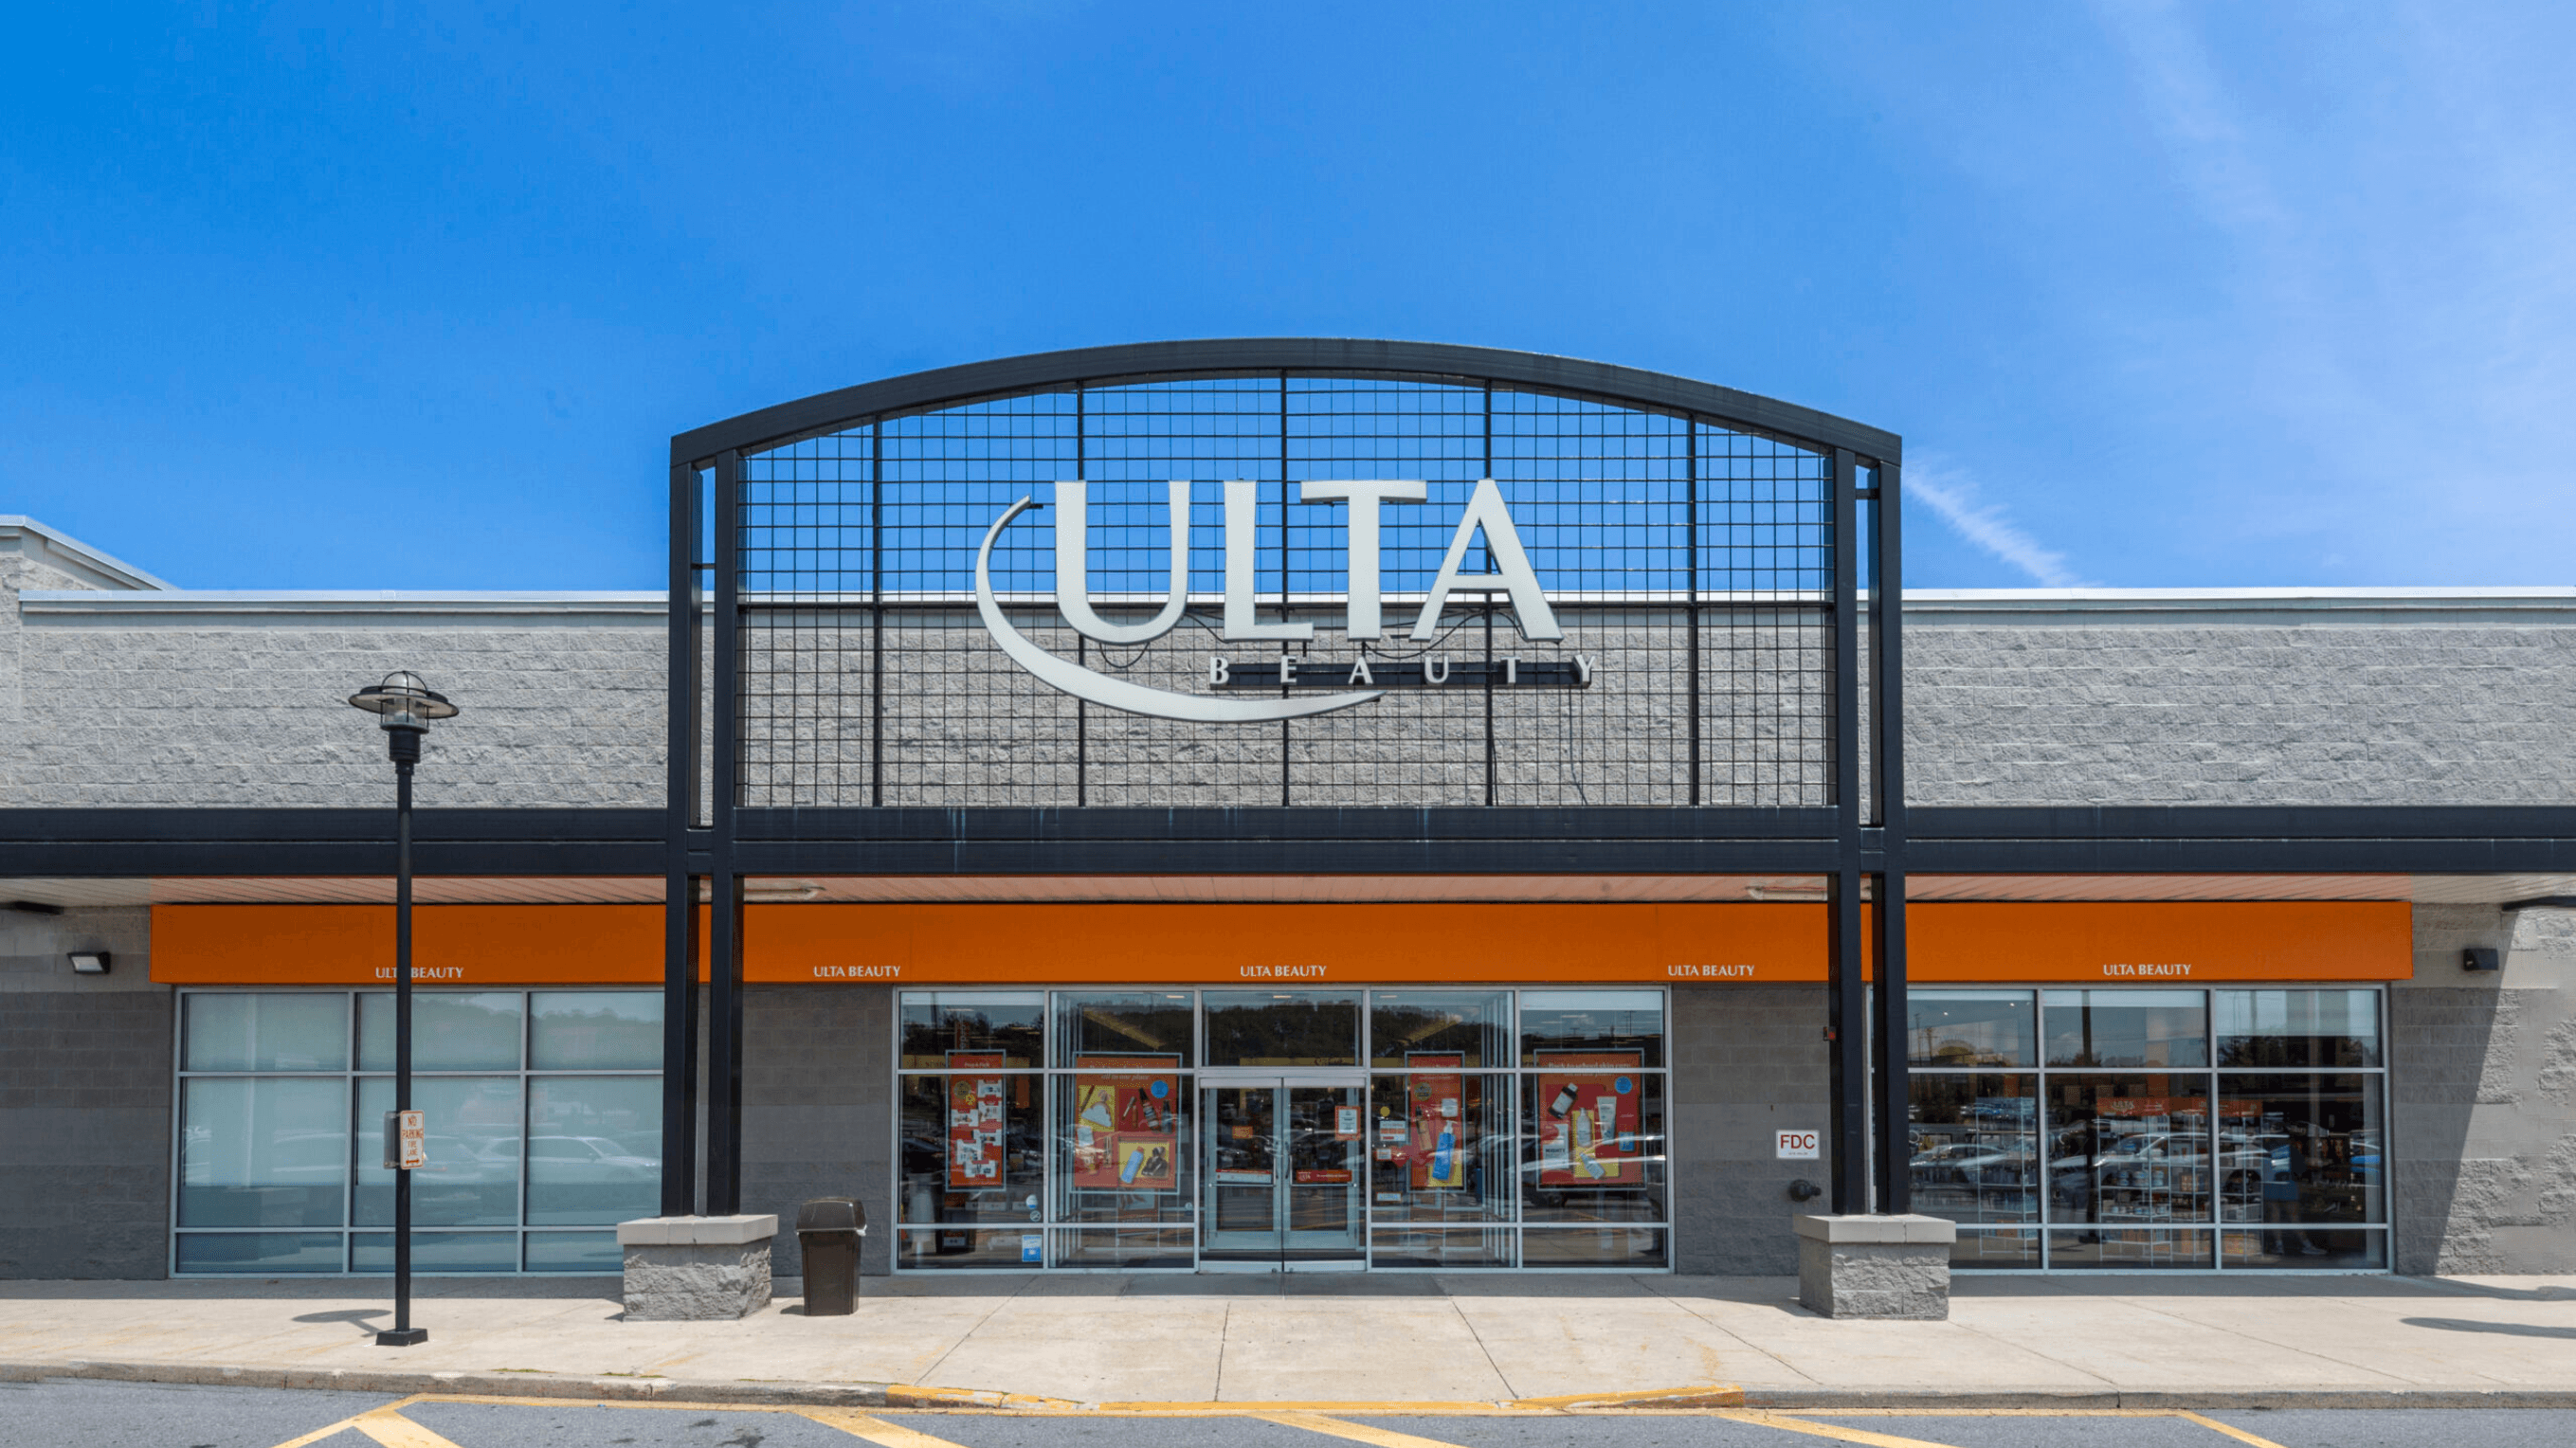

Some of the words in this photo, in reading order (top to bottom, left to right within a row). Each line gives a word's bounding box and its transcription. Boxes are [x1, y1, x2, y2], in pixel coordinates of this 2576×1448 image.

[1055, 478, 1565, 646] ULTA
[1208, 654, 1596, 688] BEAUTY
[375, 967, 397, 978] ULT
[410, 967, 463, 978] BEAUTY
[814, 966, 845, 977] ULTA
[848, 966, 900, 977] BEAUTY
[1241, 966, 1272, 977] ULTA
[1275, 965, 1327, 977] BEAUTY
[1668, 965, 1699, 976] ULTA
[1702, 965, 1754, 976] BEAUTY
[2103, 964, 2135, 976] ULTA
[2138, 964, 2191, 976] BEAUTY
[408, 1115, 418, 1127] NO
[402, 1129, 424, 1139] PARKING
[1780, 1134, 1815, 1149] FDC
